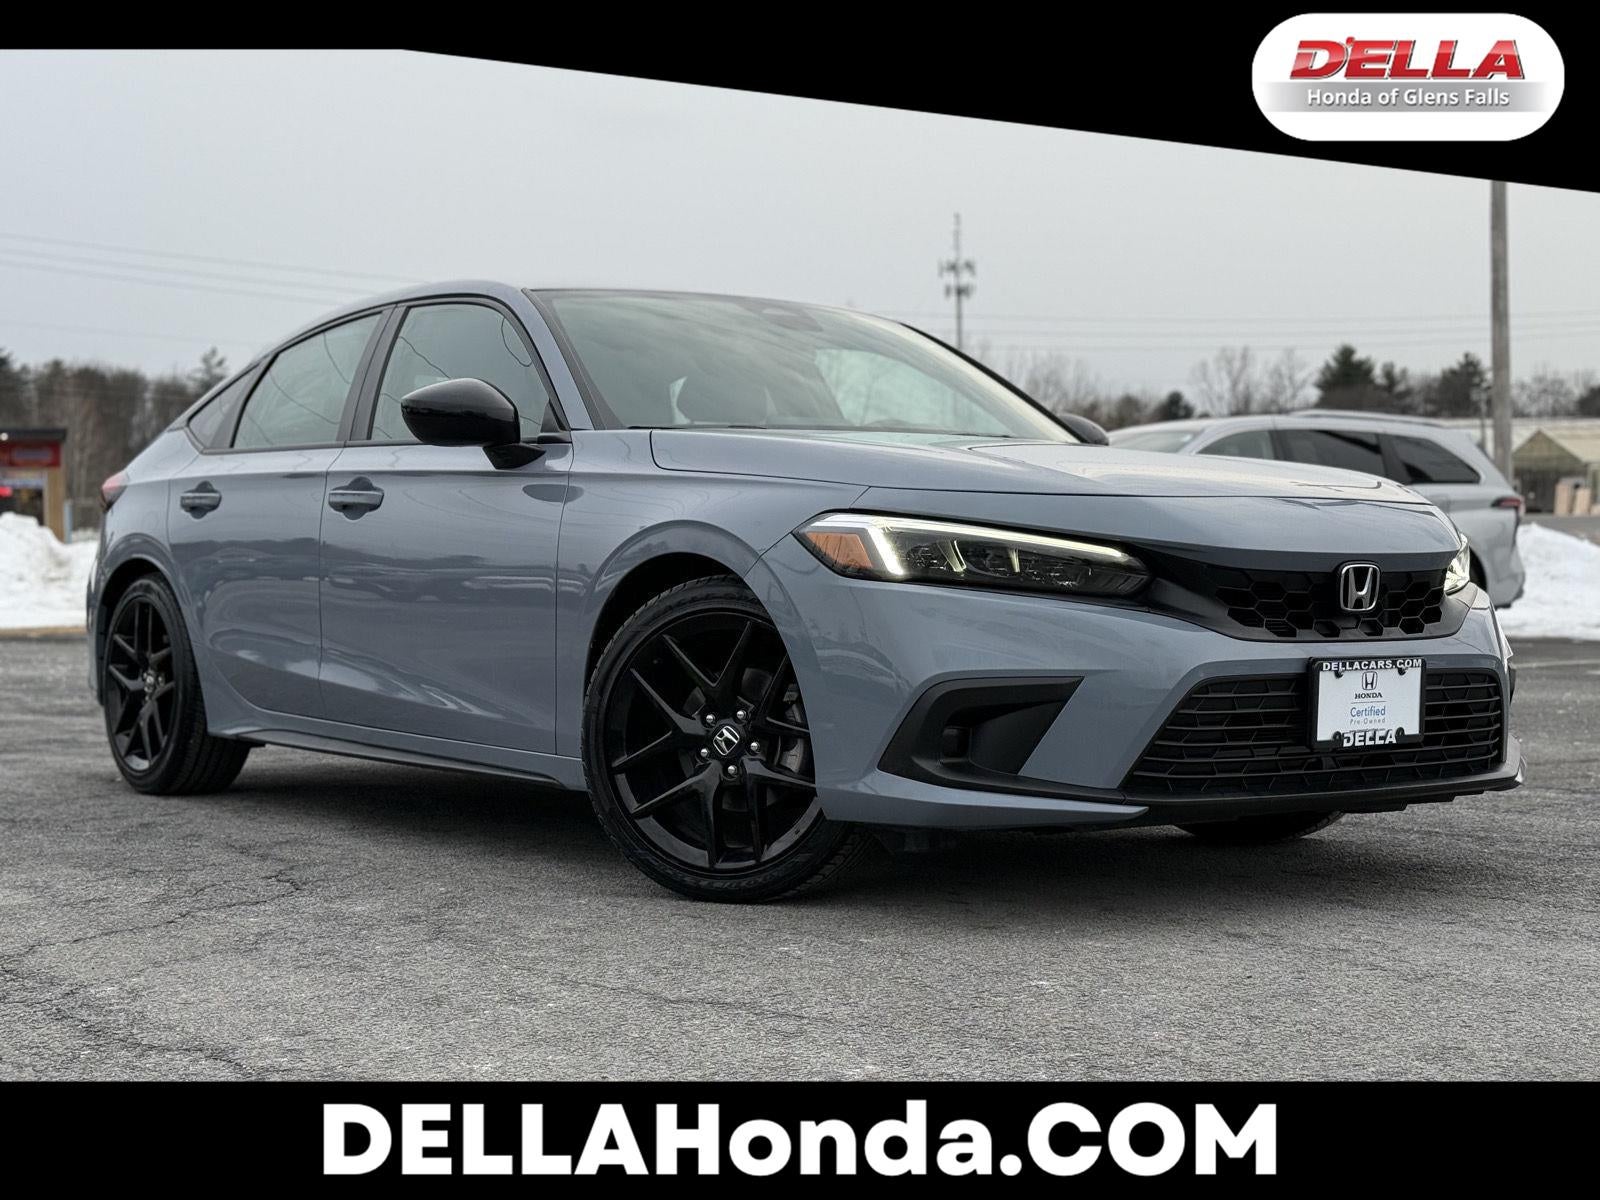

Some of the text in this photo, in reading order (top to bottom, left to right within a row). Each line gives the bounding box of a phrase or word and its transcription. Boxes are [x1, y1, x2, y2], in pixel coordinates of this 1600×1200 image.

[1322, 659, 1422, 671] DELLACARS.COM
[1350, 705, 1386, 717] Certified
[1342, 730, 1397, 747] DELLA
